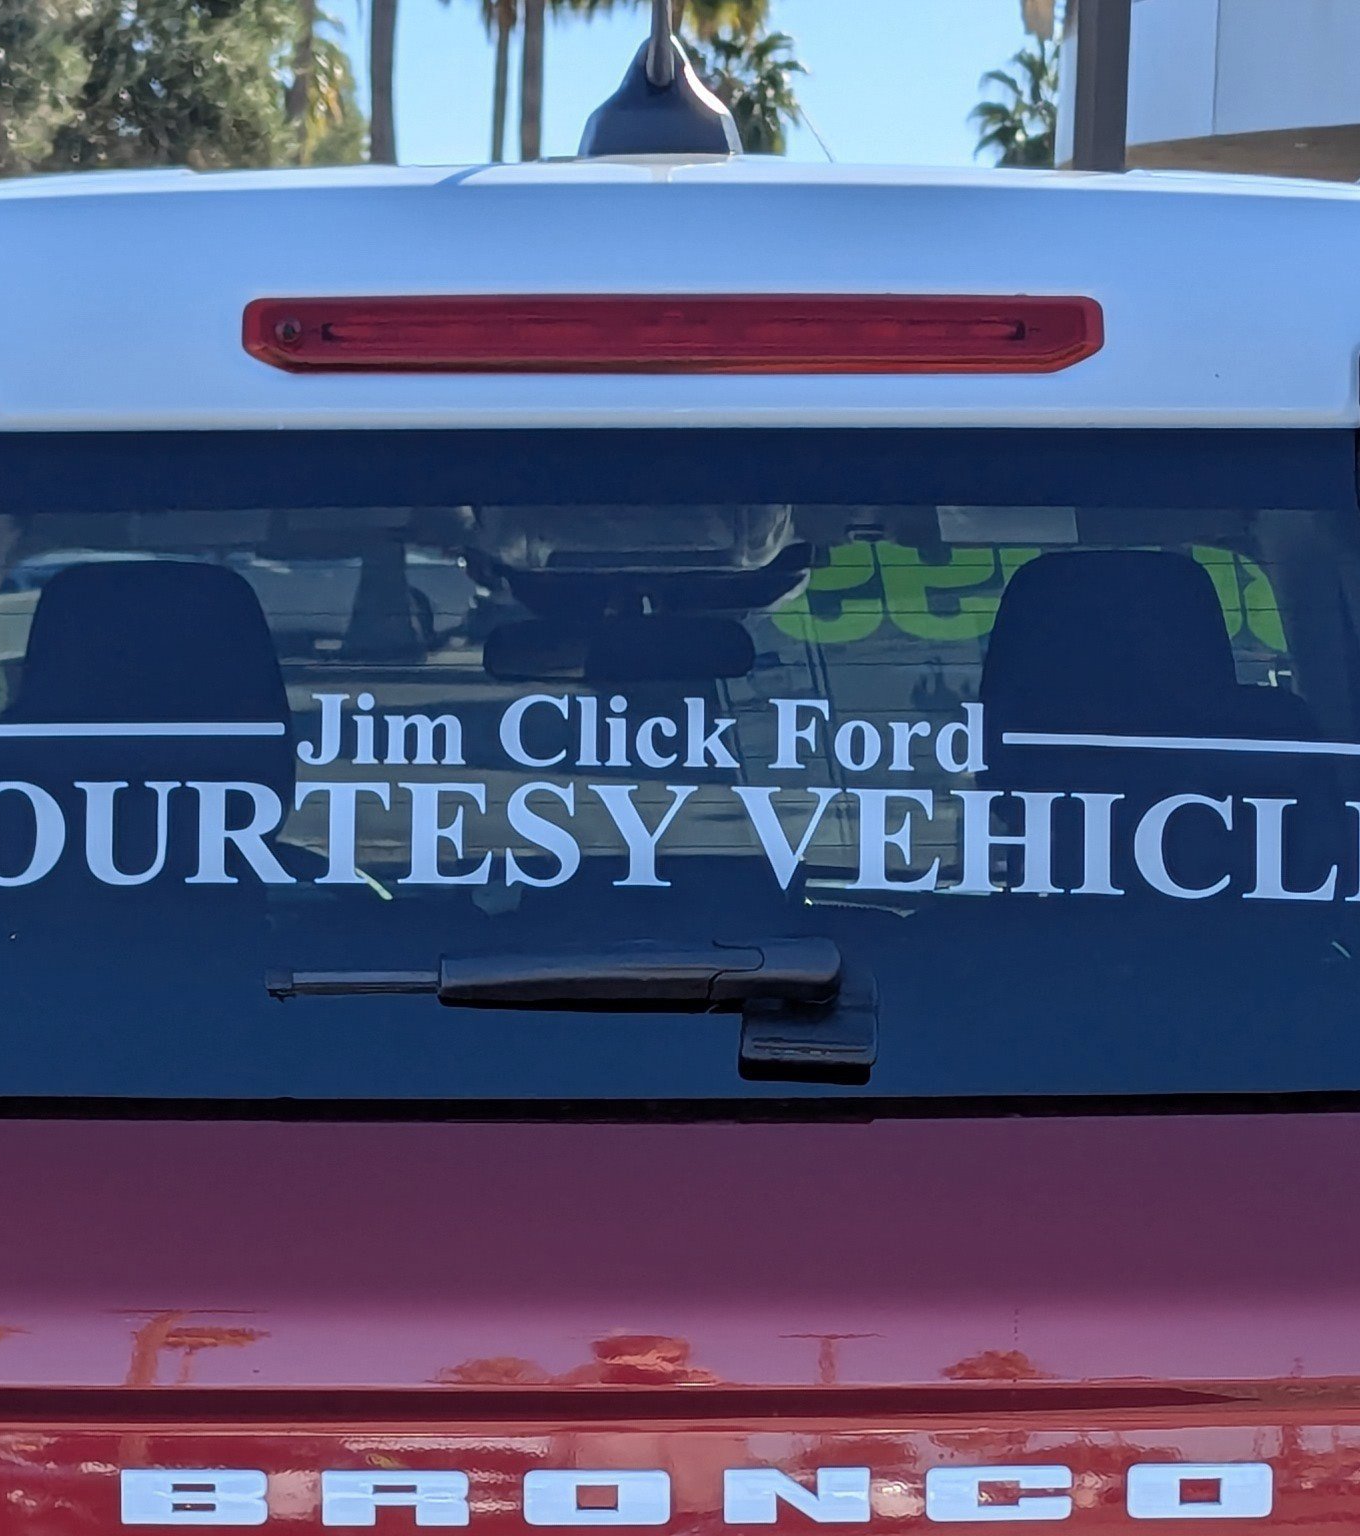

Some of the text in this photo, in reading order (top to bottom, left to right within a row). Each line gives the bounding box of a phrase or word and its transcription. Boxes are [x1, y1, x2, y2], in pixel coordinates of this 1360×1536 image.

[296, 691, 989, 774] Jim Click Ford
[120, 1462, 1274, 1526] BRONCO
